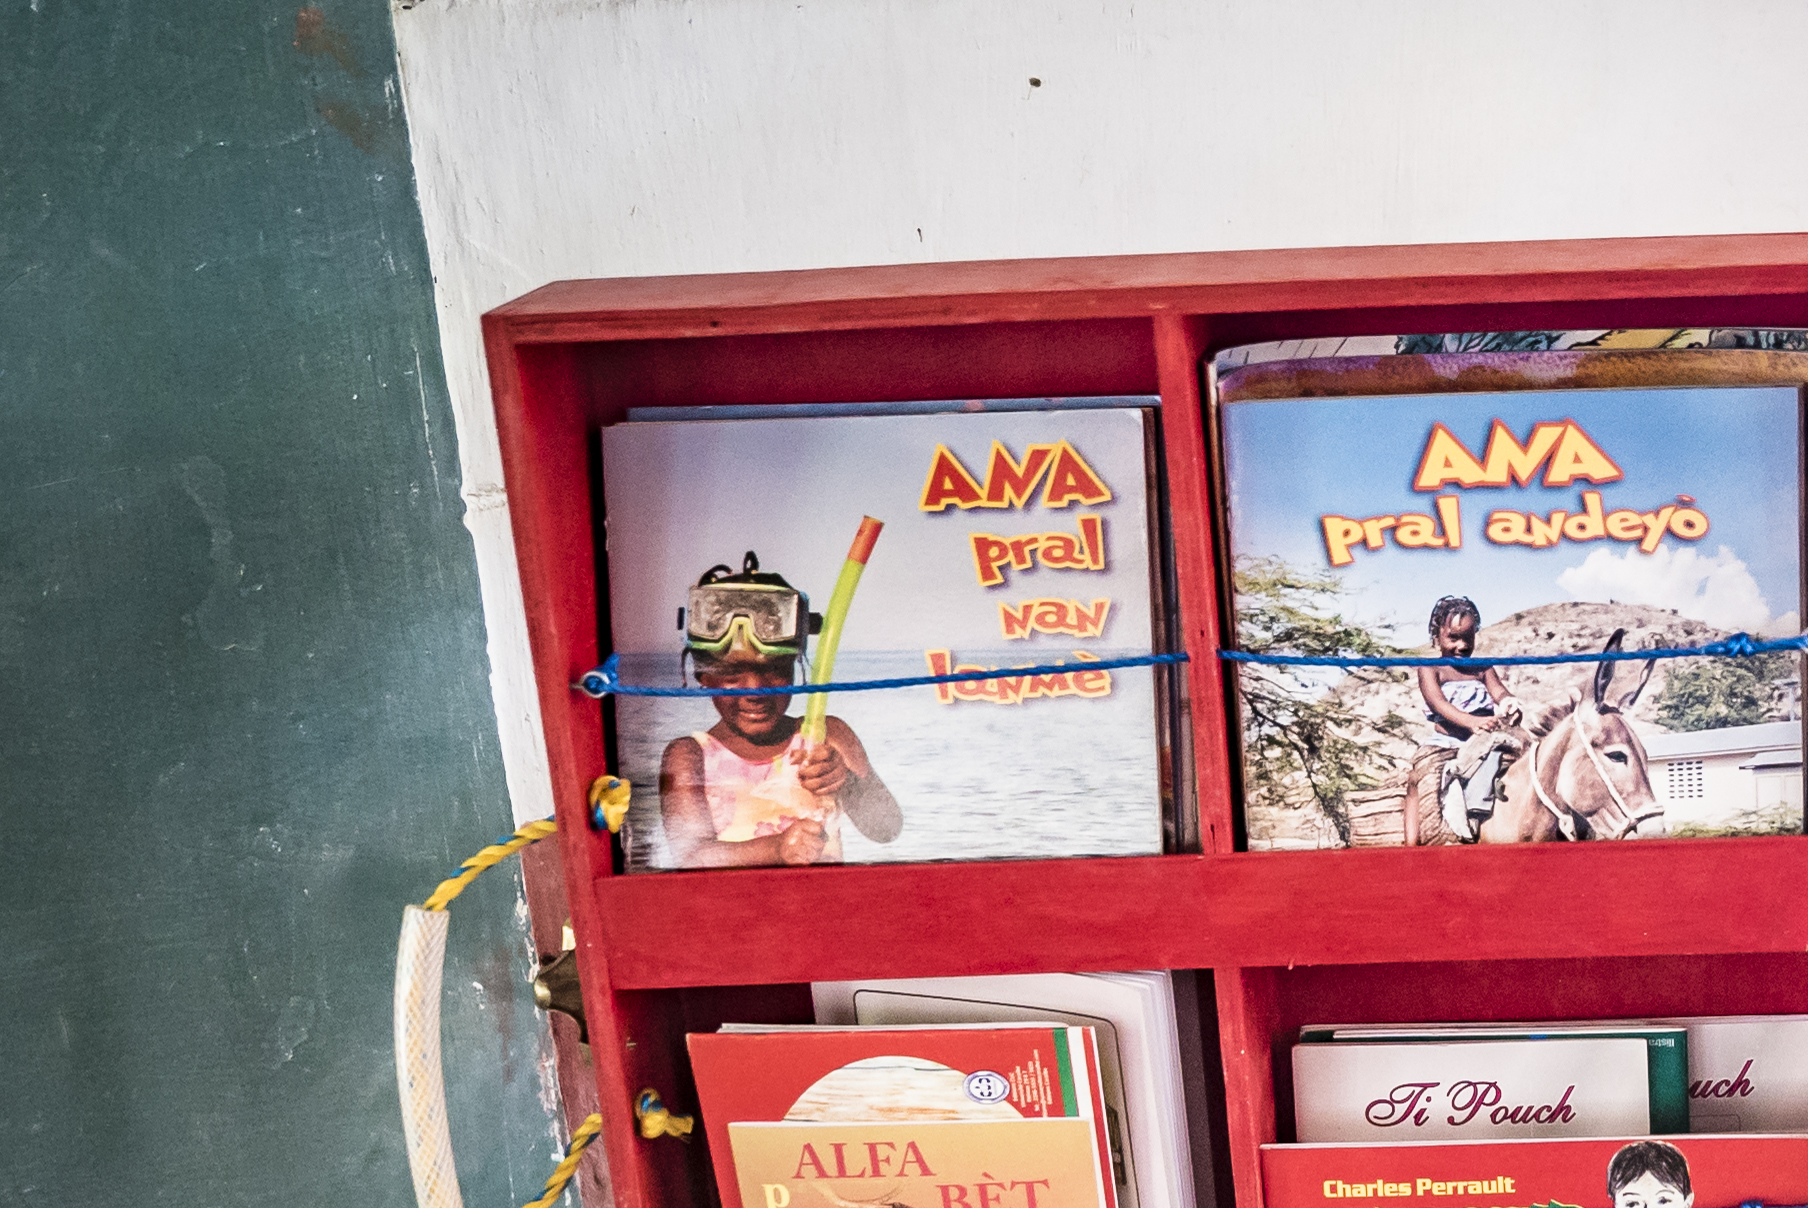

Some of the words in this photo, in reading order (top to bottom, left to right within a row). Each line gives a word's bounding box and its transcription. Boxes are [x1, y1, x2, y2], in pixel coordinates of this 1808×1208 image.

[919, 438, 1112, 511] ANA
[1413, 417, 1624, 491] ANA
[969, 513, 1105, 586] pral
[1322, 494, 1462, 567] pral
[1365, 1082, 1440, 1127] Ti
[1446, 1081, 1576, 1126] Pouch
[791, 1140, 937, 1180] ALFA
[1323, 1179, 1411, 1198] Charles
[1416, 1176, 1516, 1197] Perrault
